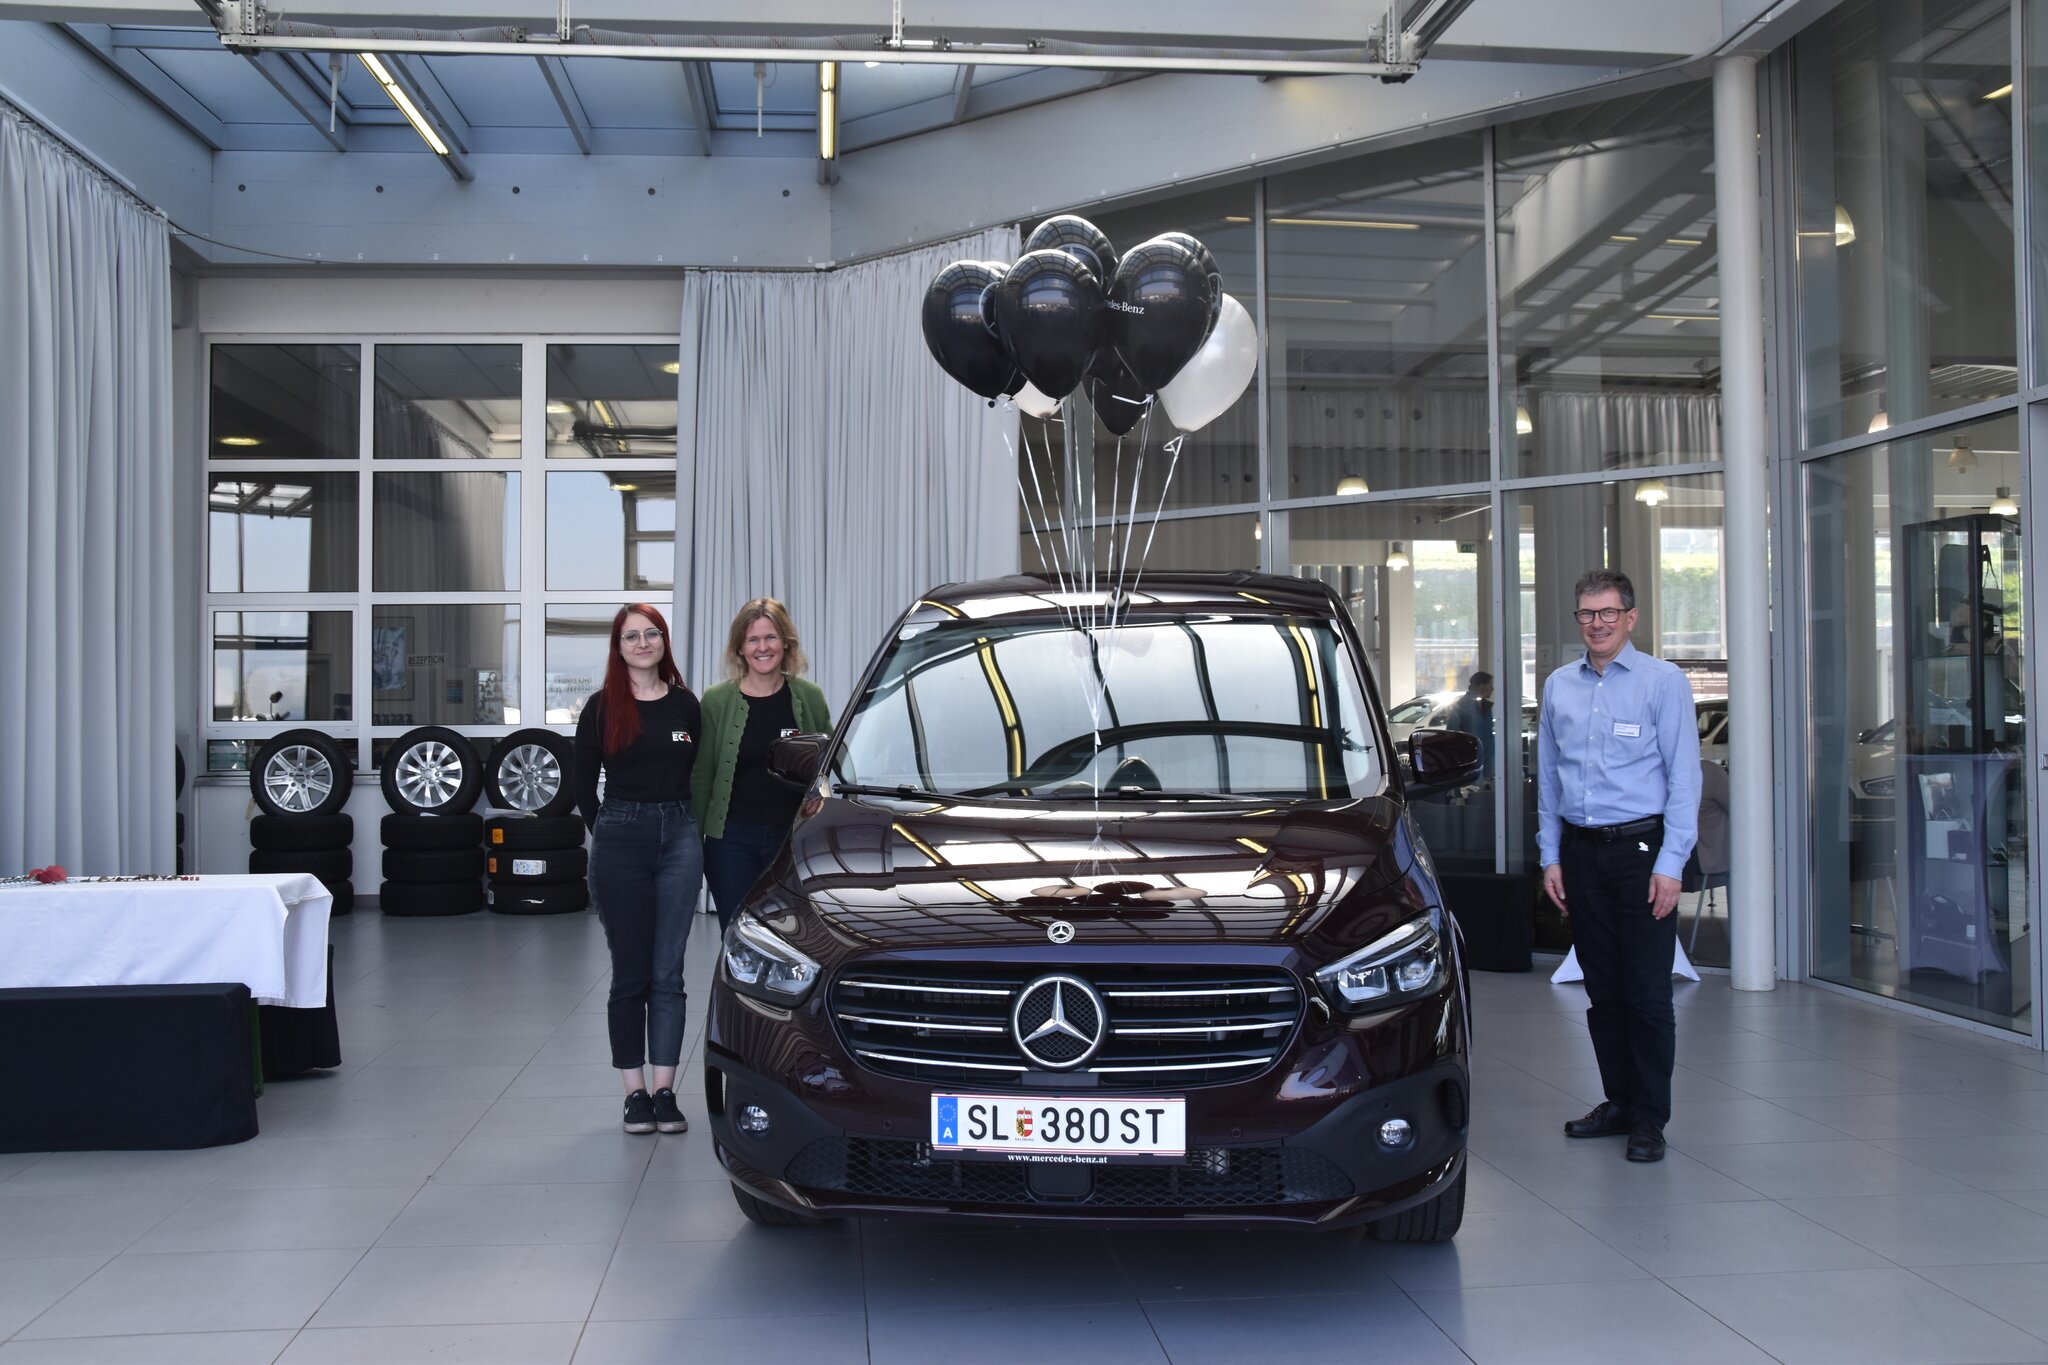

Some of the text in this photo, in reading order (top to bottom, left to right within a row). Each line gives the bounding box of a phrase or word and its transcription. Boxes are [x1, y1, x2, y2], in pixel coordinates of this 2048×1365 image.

[968, 1104, 1165, 1144] SL 380 ST
[943, 1127, 953, 1139] A
[1007, 1154, 1108, 1164] www.mercedes-benz.at
